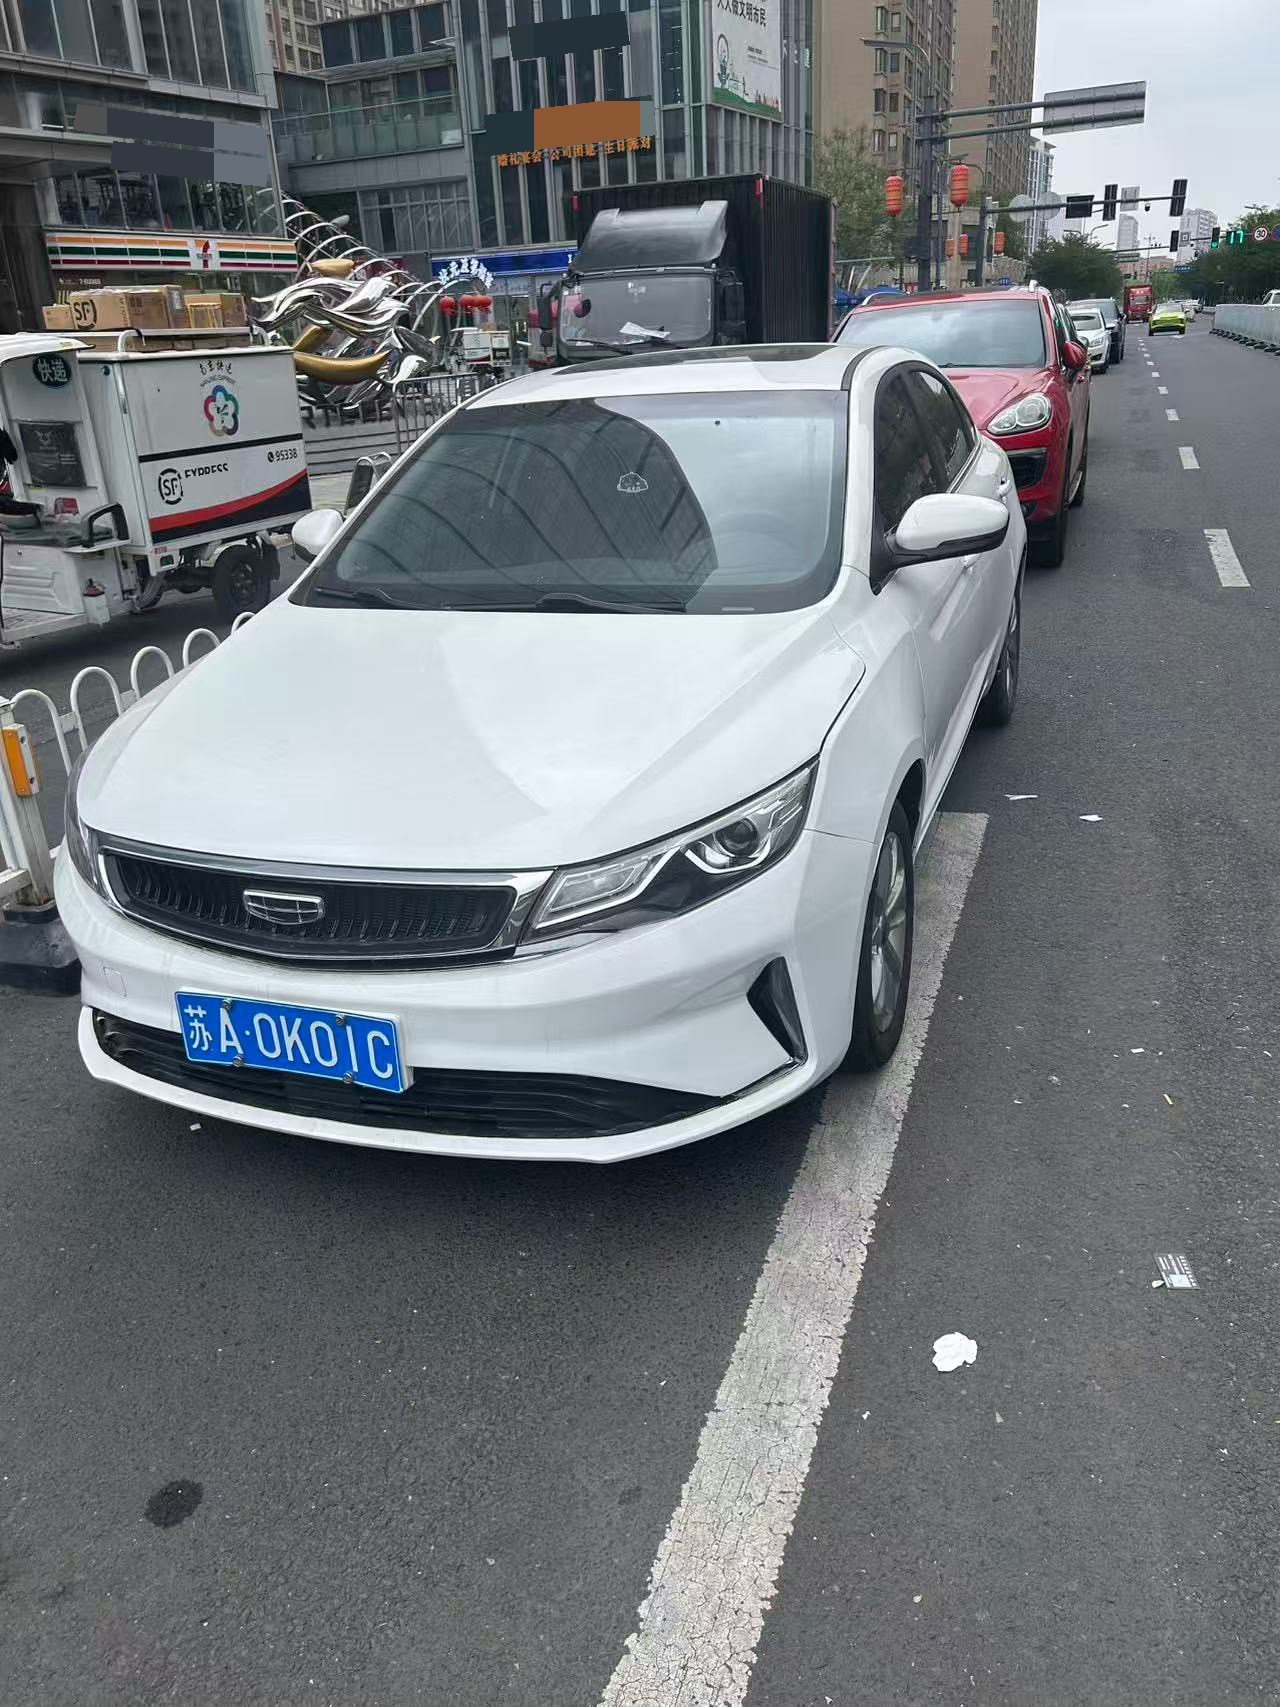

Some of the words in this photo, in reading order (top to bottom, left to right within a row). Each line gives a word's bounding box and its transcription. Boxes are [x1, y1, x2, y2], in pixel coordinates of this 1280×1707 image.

[1256, 230, 1265, 238] 30
[38, 359, 68, 382] 快递
[276, 448, 297, 461] 95338
